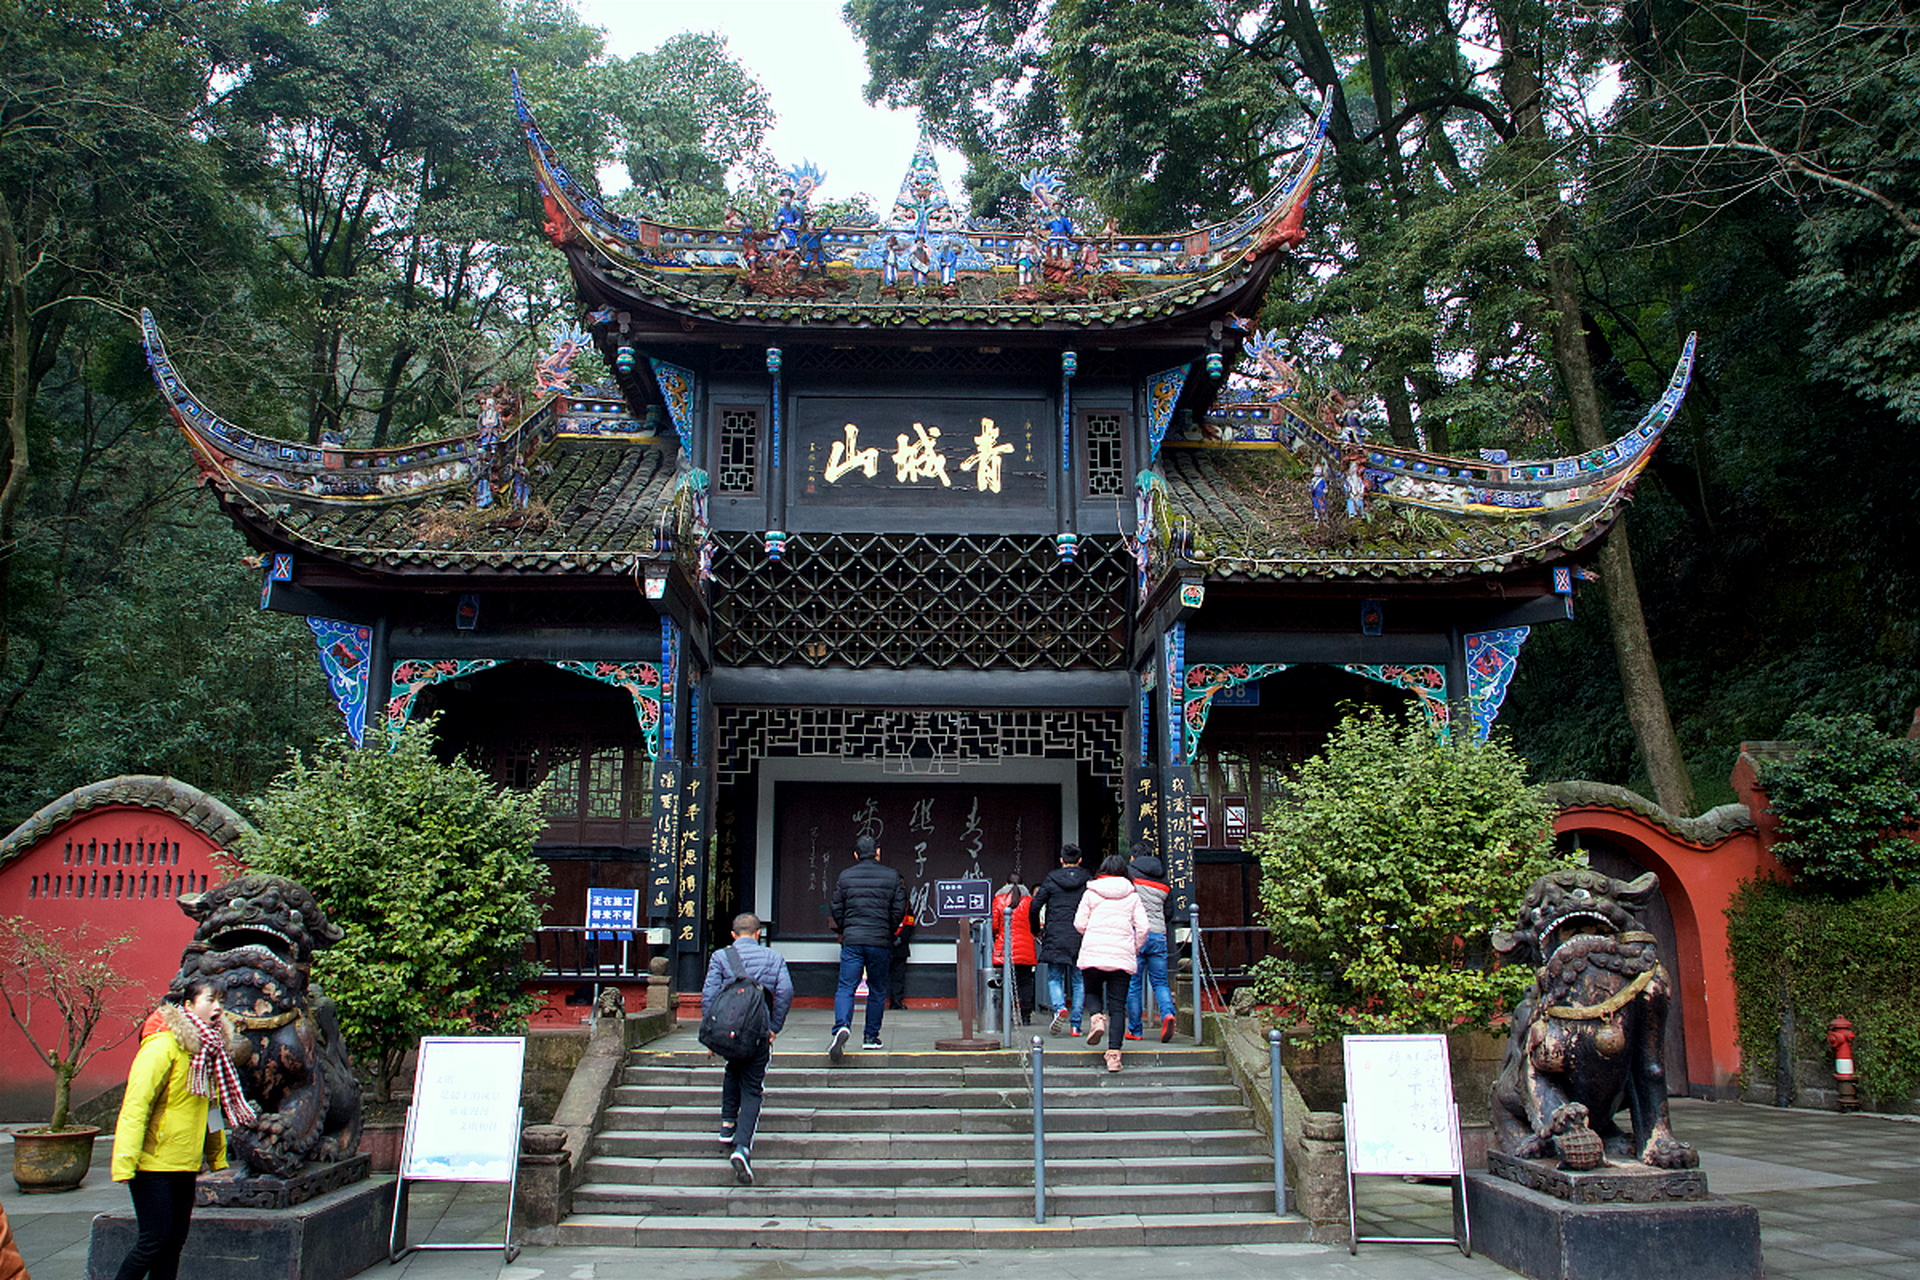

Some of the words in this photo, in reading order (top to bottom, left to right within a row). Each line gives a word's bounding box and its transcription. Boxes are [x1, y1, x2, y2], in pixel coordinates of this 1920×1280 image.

[824, 417, 1015, 494] 青城山
[592, 895, 633, 907] 正在施工
[945, 895, 966, 904] 入口
